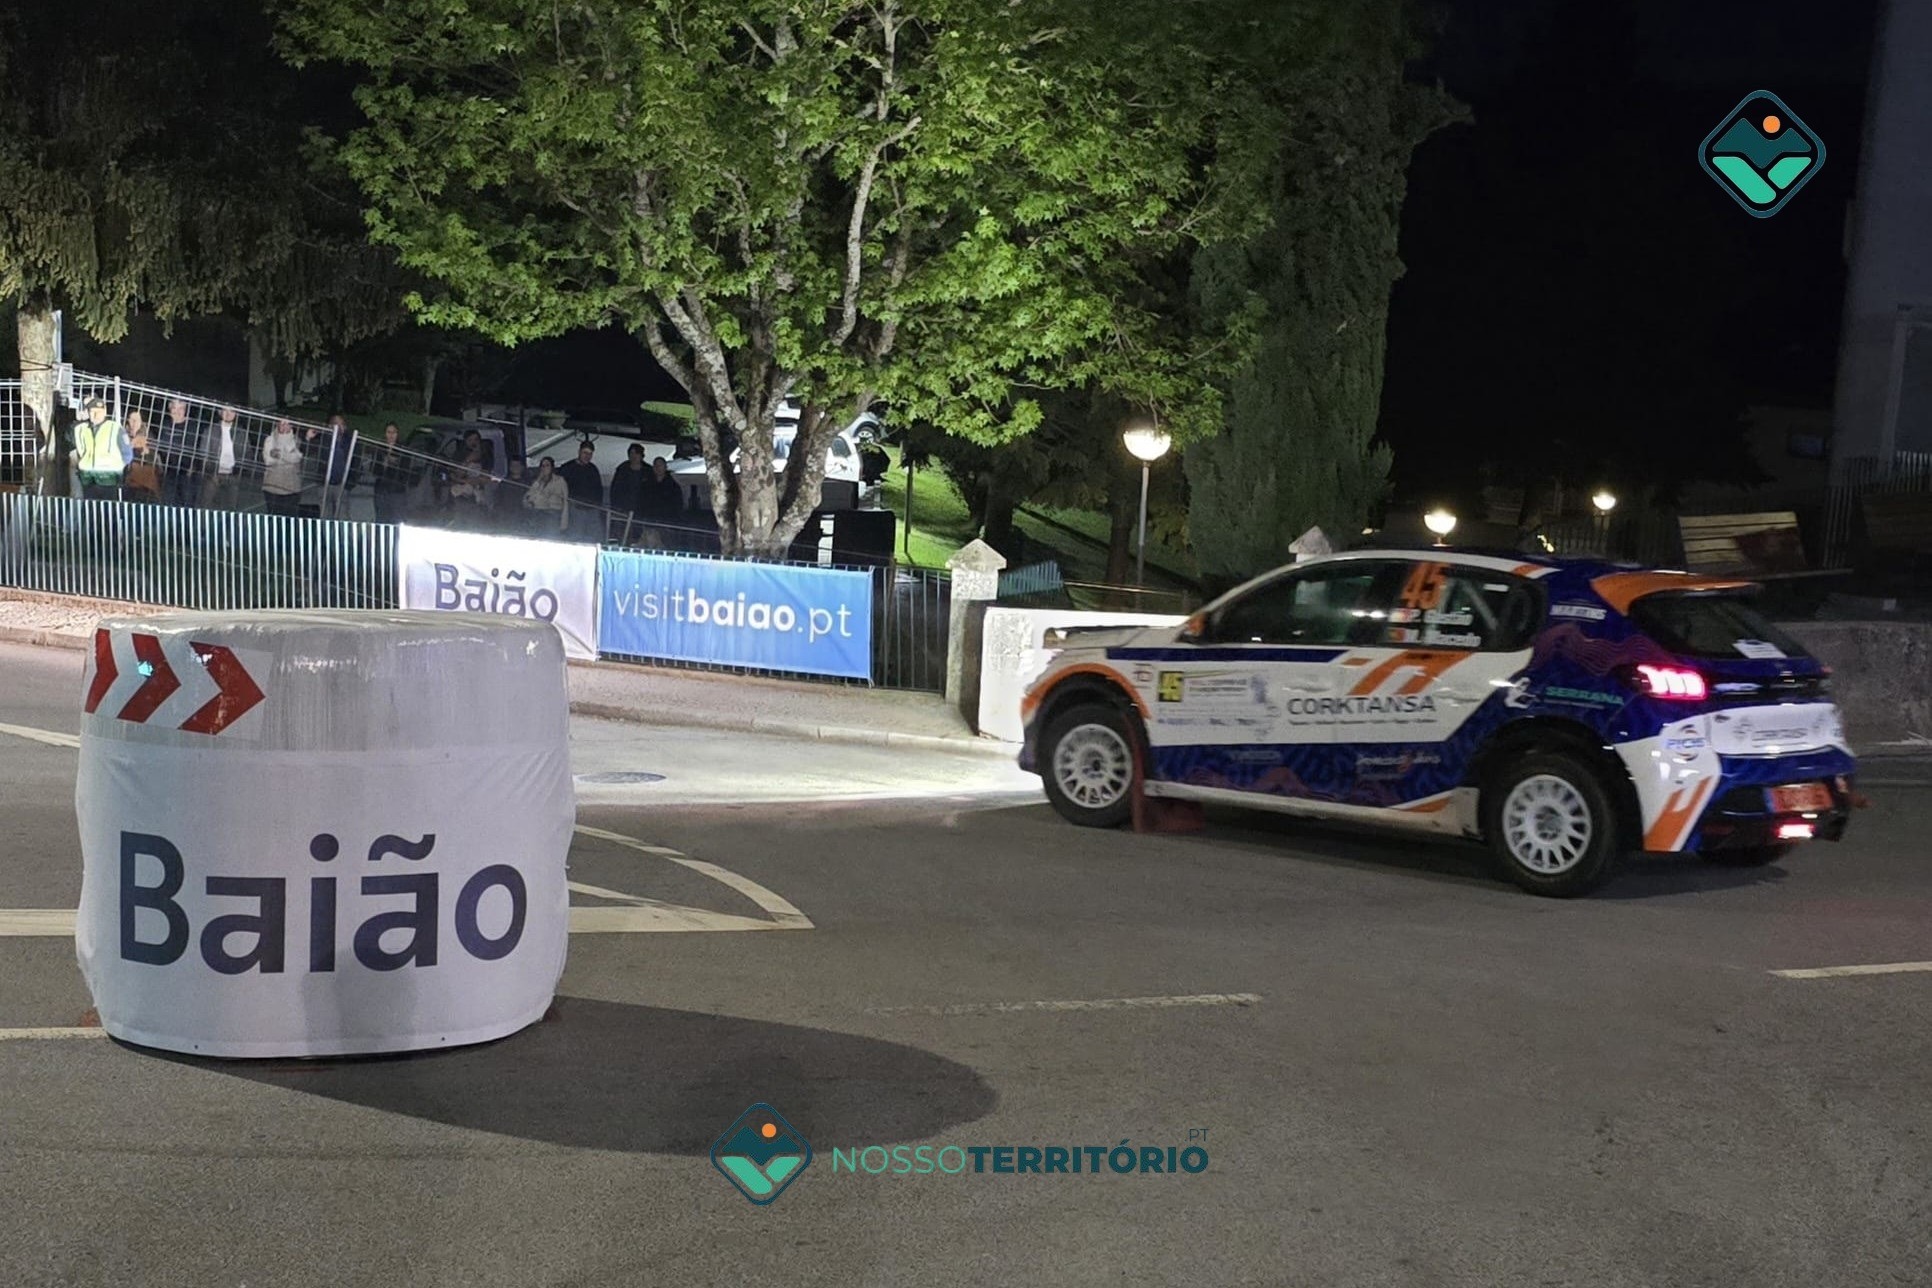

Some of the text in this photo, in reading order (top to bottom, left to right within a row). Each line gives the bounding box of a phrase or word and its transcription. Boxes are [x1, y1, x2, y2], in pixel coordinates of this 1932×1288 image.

[433, 562, 558, 623] Baião
[614, 582, 852, 644] visitbaiao.pt
[1400, 561, 1449, 610] 45
[1287, 695, 1436, 715] CORKTANSA
[119, 830, 528, 976] Baião
